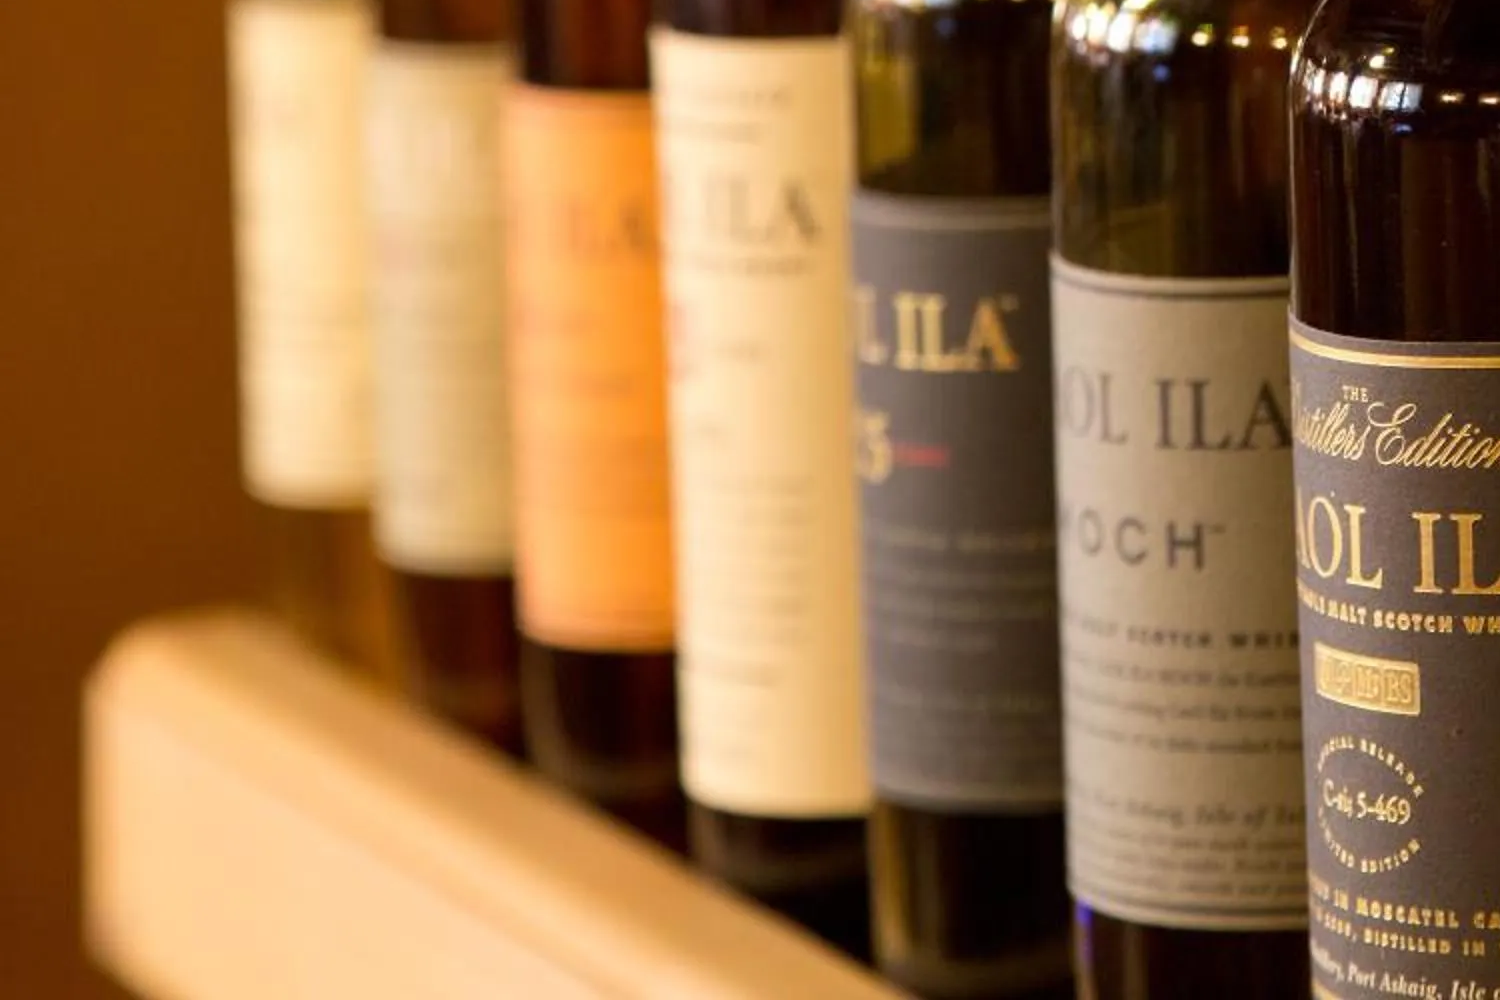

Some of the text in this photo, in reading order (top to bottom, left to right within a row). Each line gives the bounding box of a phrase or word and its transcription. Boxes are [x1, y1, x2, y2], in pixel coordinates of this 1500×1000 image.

[895, 290, 1020, 371] ILA
[1342, 385, 1369, 403] THE
[1155, 378, 1292, 450] ILA
[1076, 507, 1206, 571] OCH
[1373, 609, 1454, 634] SCOTCH
[1355, 895, 1460, 930] MOSCATEL
[1362, 927, 1452, 955] DISTILLED
[1462, 940, 1486, 957] IN
[1348, 962, 1376, 991] Port
[1451, 979, 1487, 1000] Isle
